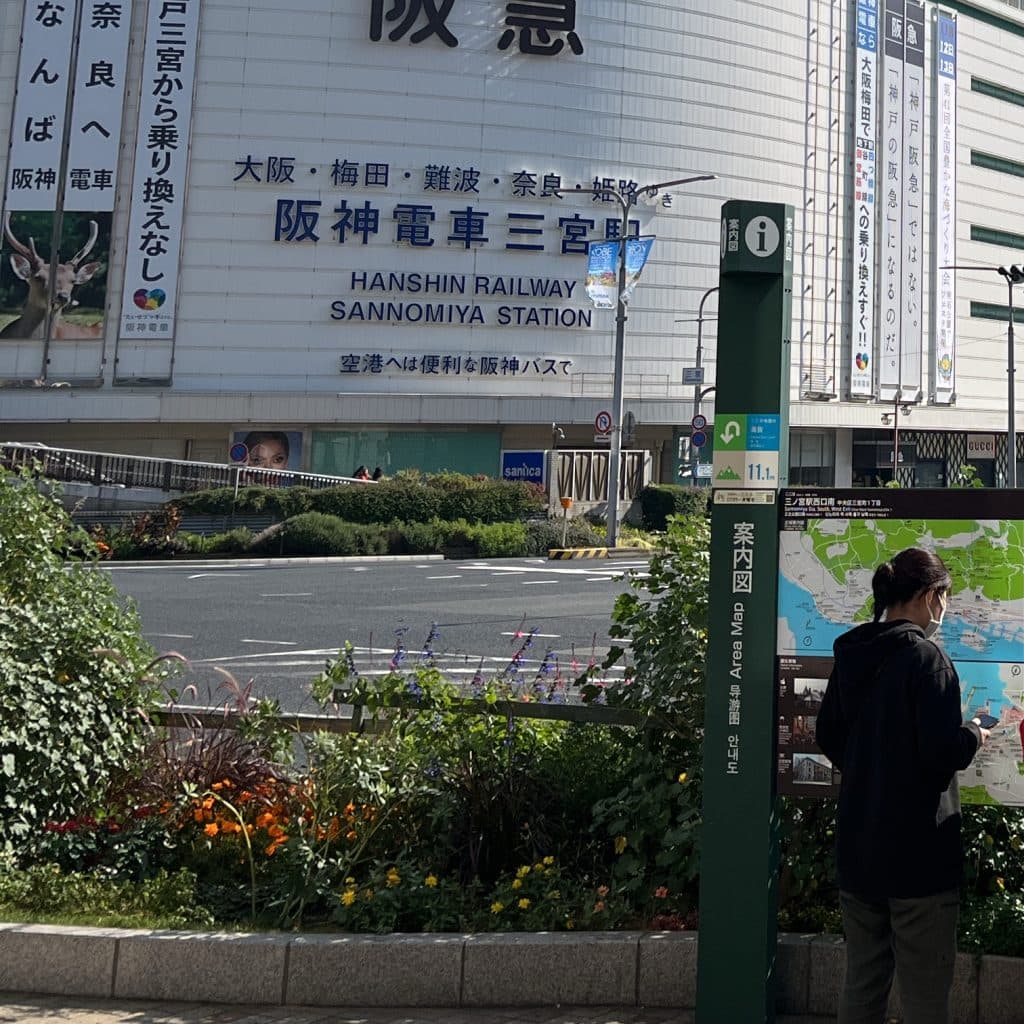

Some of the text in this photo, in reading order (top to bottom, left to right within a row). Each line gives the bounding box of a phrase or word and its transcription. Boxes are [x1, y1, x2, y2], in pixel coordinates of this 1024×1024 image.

[858, 32, 875, 49] なら
[891, 17, 917, 44] 阪急
[24, 0, 65, 143] なんば
[82, 2, 122, 139] 奈良へ
[350, 271, 577, 299] HANSHIN RAILWAY
[330, 301, 593, 329] SANNOMIYA STATION
[339, 353, 573, 376] 空港へは便利な阪神バスで
[968, 441, 994, 451] GUCCI
[784, 497, 835, 506] 三ノ宮駅西口南
[732, 521, 755, 594] 案内図
[730, 602, 745, 679] Area Map
